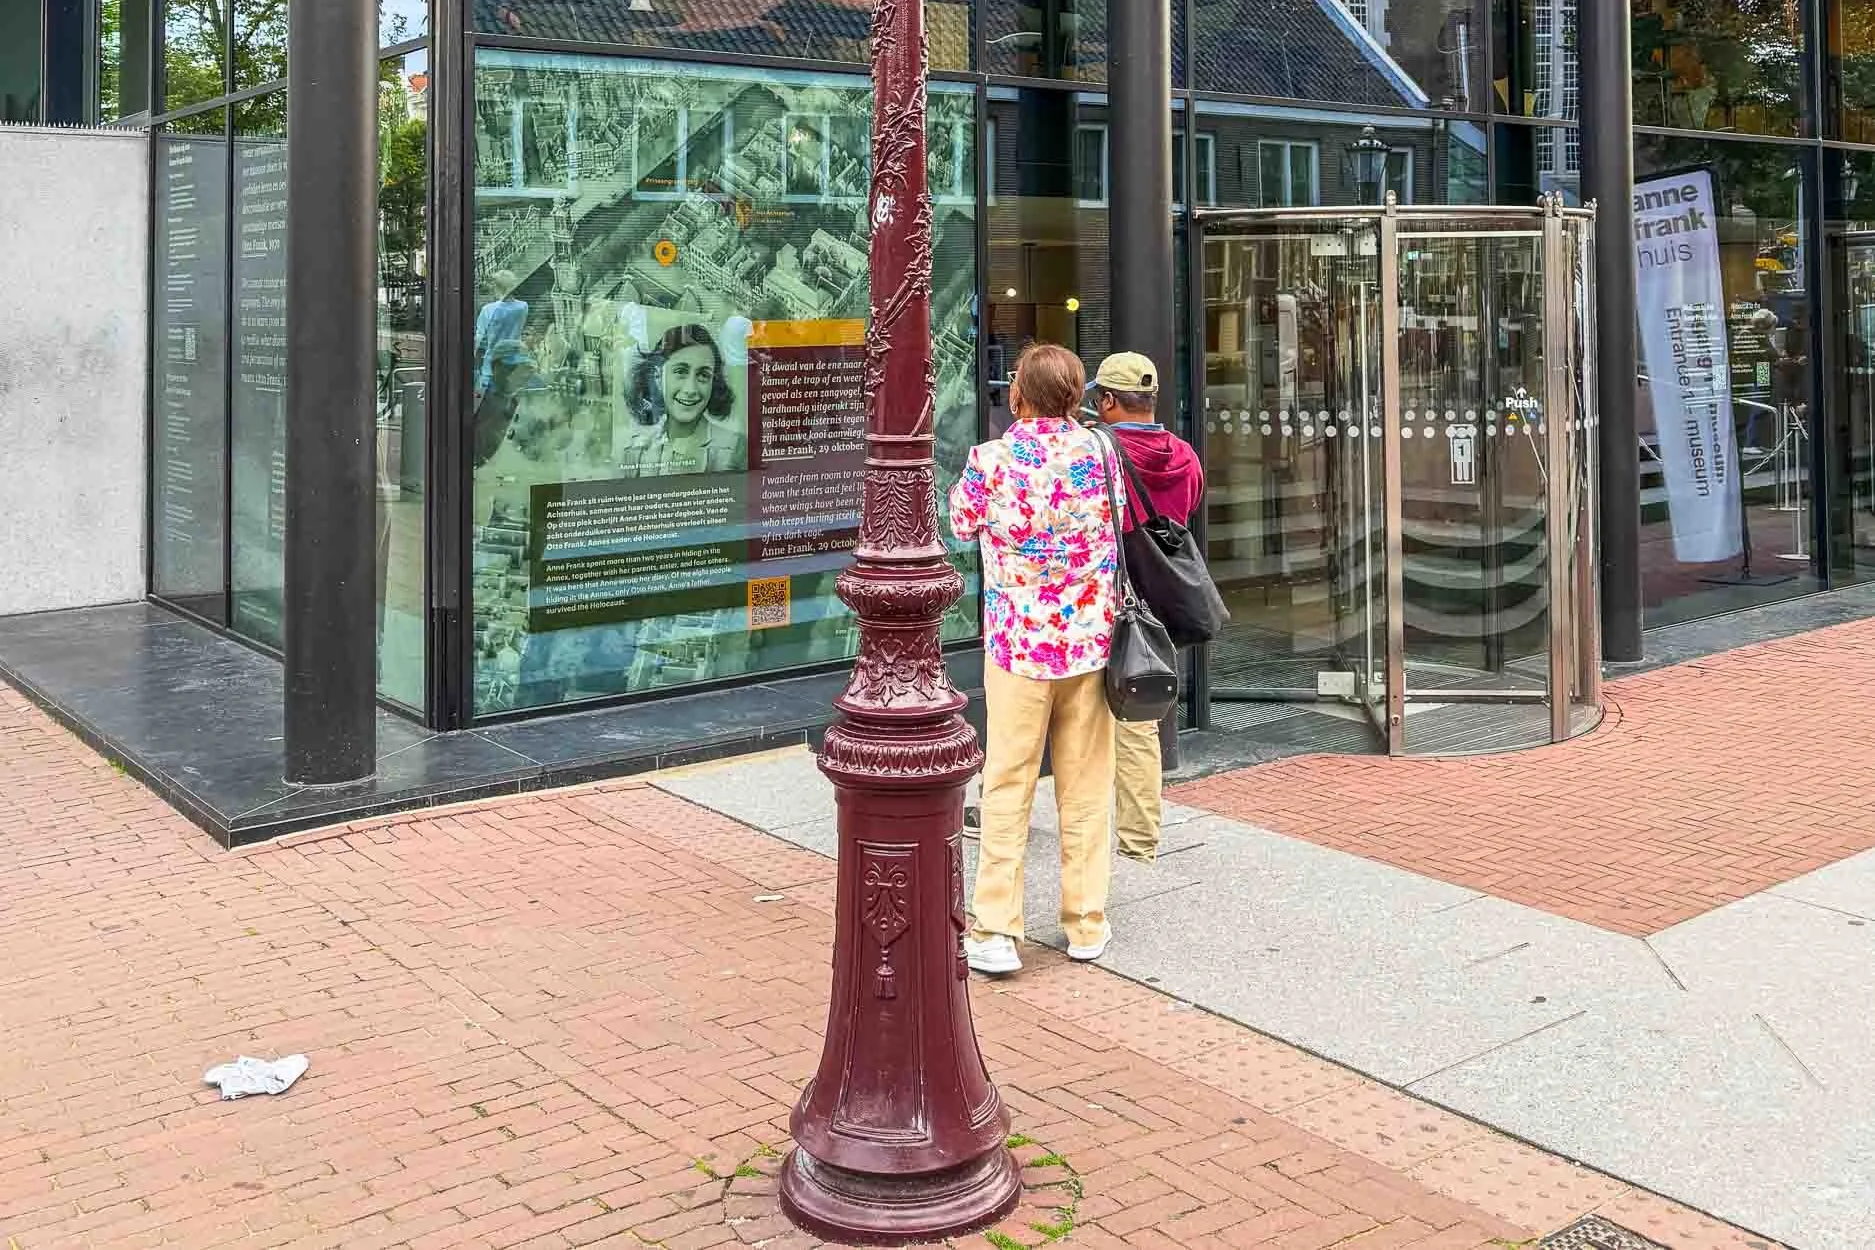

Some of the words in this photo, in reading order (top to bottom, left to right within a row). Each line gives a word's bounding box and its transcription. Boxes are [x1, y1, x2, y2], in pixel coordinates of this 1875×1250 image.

[1634, 185, 1698, 212] anne
[1635, 207, 1707, 240] frank
[1637, 240, 1693, 268] huis
[1665, 308, 1690, 387] Entrance
[762, 362, 770, 372] Ik
[772, 362, 798, 371] dwaal
[800, 362, 814, 371] van
[816, 360, 826, 370] de
[827, 362, 841, 370] ene
[843, 361, 862, 369] naar
[762, 377, 790, 387] kamer,
[791, 376, 802, 385] de
[804, 376, 820, 386] trap
[822, 374, 831, 385] af
[832, 375, 842, 383] en
[843, 374, 863, 382] weer
[762, 390, 789, 402] gevoel
[791, 389, 802, 399] als
[804, 390, 818, 398] een
[820, 386, 862, 398] zangvogel,
[1682, 391, 1695, 399] 1
[762, 403, 810, 414] hardhandig
[812, 401, 848, 413] uitgerukt
[850, 400, 865, 411] zijn
[1505, 396, 1538, 409] Push
[762, 418, 801, 429] volslagen
[802, 415, 842, 426] duisternis
[844, 415, 865, 425] tegen
[762, 433, 778, 445] zijn
[780, 433, 807, 441] nauwe
[809, 430, 826, 440] kooi
[762, 446, 785, 457] Anne
[788, 445, 817, 455] Frank,
[818, 444, 830, 453] 29
[831, 441, 865, 452] oktober
[1688, 420, 1710, 496] museum
[762, 476, 766, 486] I
[767, 474, 799, 485] wander
[799, 472, 819, 484] from
[820, 472, 841, 481] room
[844, 470, 851, 479] to
[567, 498, 587, 507] Frank
[633, 494, 646, 502] jaar
[647, 493, 662, 501] lang
[663, 488, 710, 498] ondergedoken
[711, 487, 718, 495] in
[762, 489, 785, 499] down
[787, 487, 800, 497] the
[801, 486, 823, 496] stairs
[824, 484, 840, 494] and
[841, 483, 855, 495] feel
[547, 510, 589, 519] Achterhuis,
[645, 502, 670, 510] ouders,
[693, 498, 705, 506] vier
[706, 497, 736, 505] anderen.
[762, 504, 787, 514] whose
[790, 501, 813, 513] wings
[815, 500, 833, 509] have
[835, 498, 854, 507] been
[547, 522, 558, 530] Op
[576, 519, 592, 528] plek
[593, 516, 618, 525] schrijft
[638, 513, 658, 521] Frank
[674, 509, 705, 518] dagboek.
[762, 518, 779, 527] who
[782, 516, 804, 527] keeps
[805, 512, 834, 524] hurling
[835, 509, 855, 520] itself
[546, 532, 563, 540] acht
[563, 529, 612, 538] onderduikers
[625, 525, 638, 533] het
[638, 522, 675, 532] Achterhuis
[676, 519, 706, 527] overleeft
[706, 517, 727, 525] alleen
[762, 532, 771, 544] of
[772, 531, 782, 541] its
[784, 530, 802, 540] dark
[804, 529, 824, 540] cage.
[564, 541, 587, 549] Frank,
[587, 538, 610, 546] Annes
[611, 536, 633, 544] vader,
[633, 534, 642, 542] de
[762, 547, 785, 557] Anne
[788, 542, 816, 553] Frank,
[818, 542, 829, 551] 29
[566, 562, 586, 570] Frank
[586, 560, 606, 568] spent
[606, 558, 625, 566] more
[656, 553, 673, 561] years
[681, 549, 702, 557] hiding
[546, 575, 571, 583] Annex,
[572, 570, 602, 580] together
[603, 568, 618, 576] with
[619, 567, 630, 575] her
[631, 565, 658, 574] parents,
[660, 562, 679, 570] sister,
[600, 579, 617, 587] Anne
[618, 577, 639, 585] wrote
[640, 575, 650, 583] her
[652, 573, 670, 582] diary.
[671, 571, 680, 579] Of
[680, 570, 691, 578] the
[710, 566, 732, 575] people
[546, 605, 577, 614] survived
[577, 603, 589, 611] the
